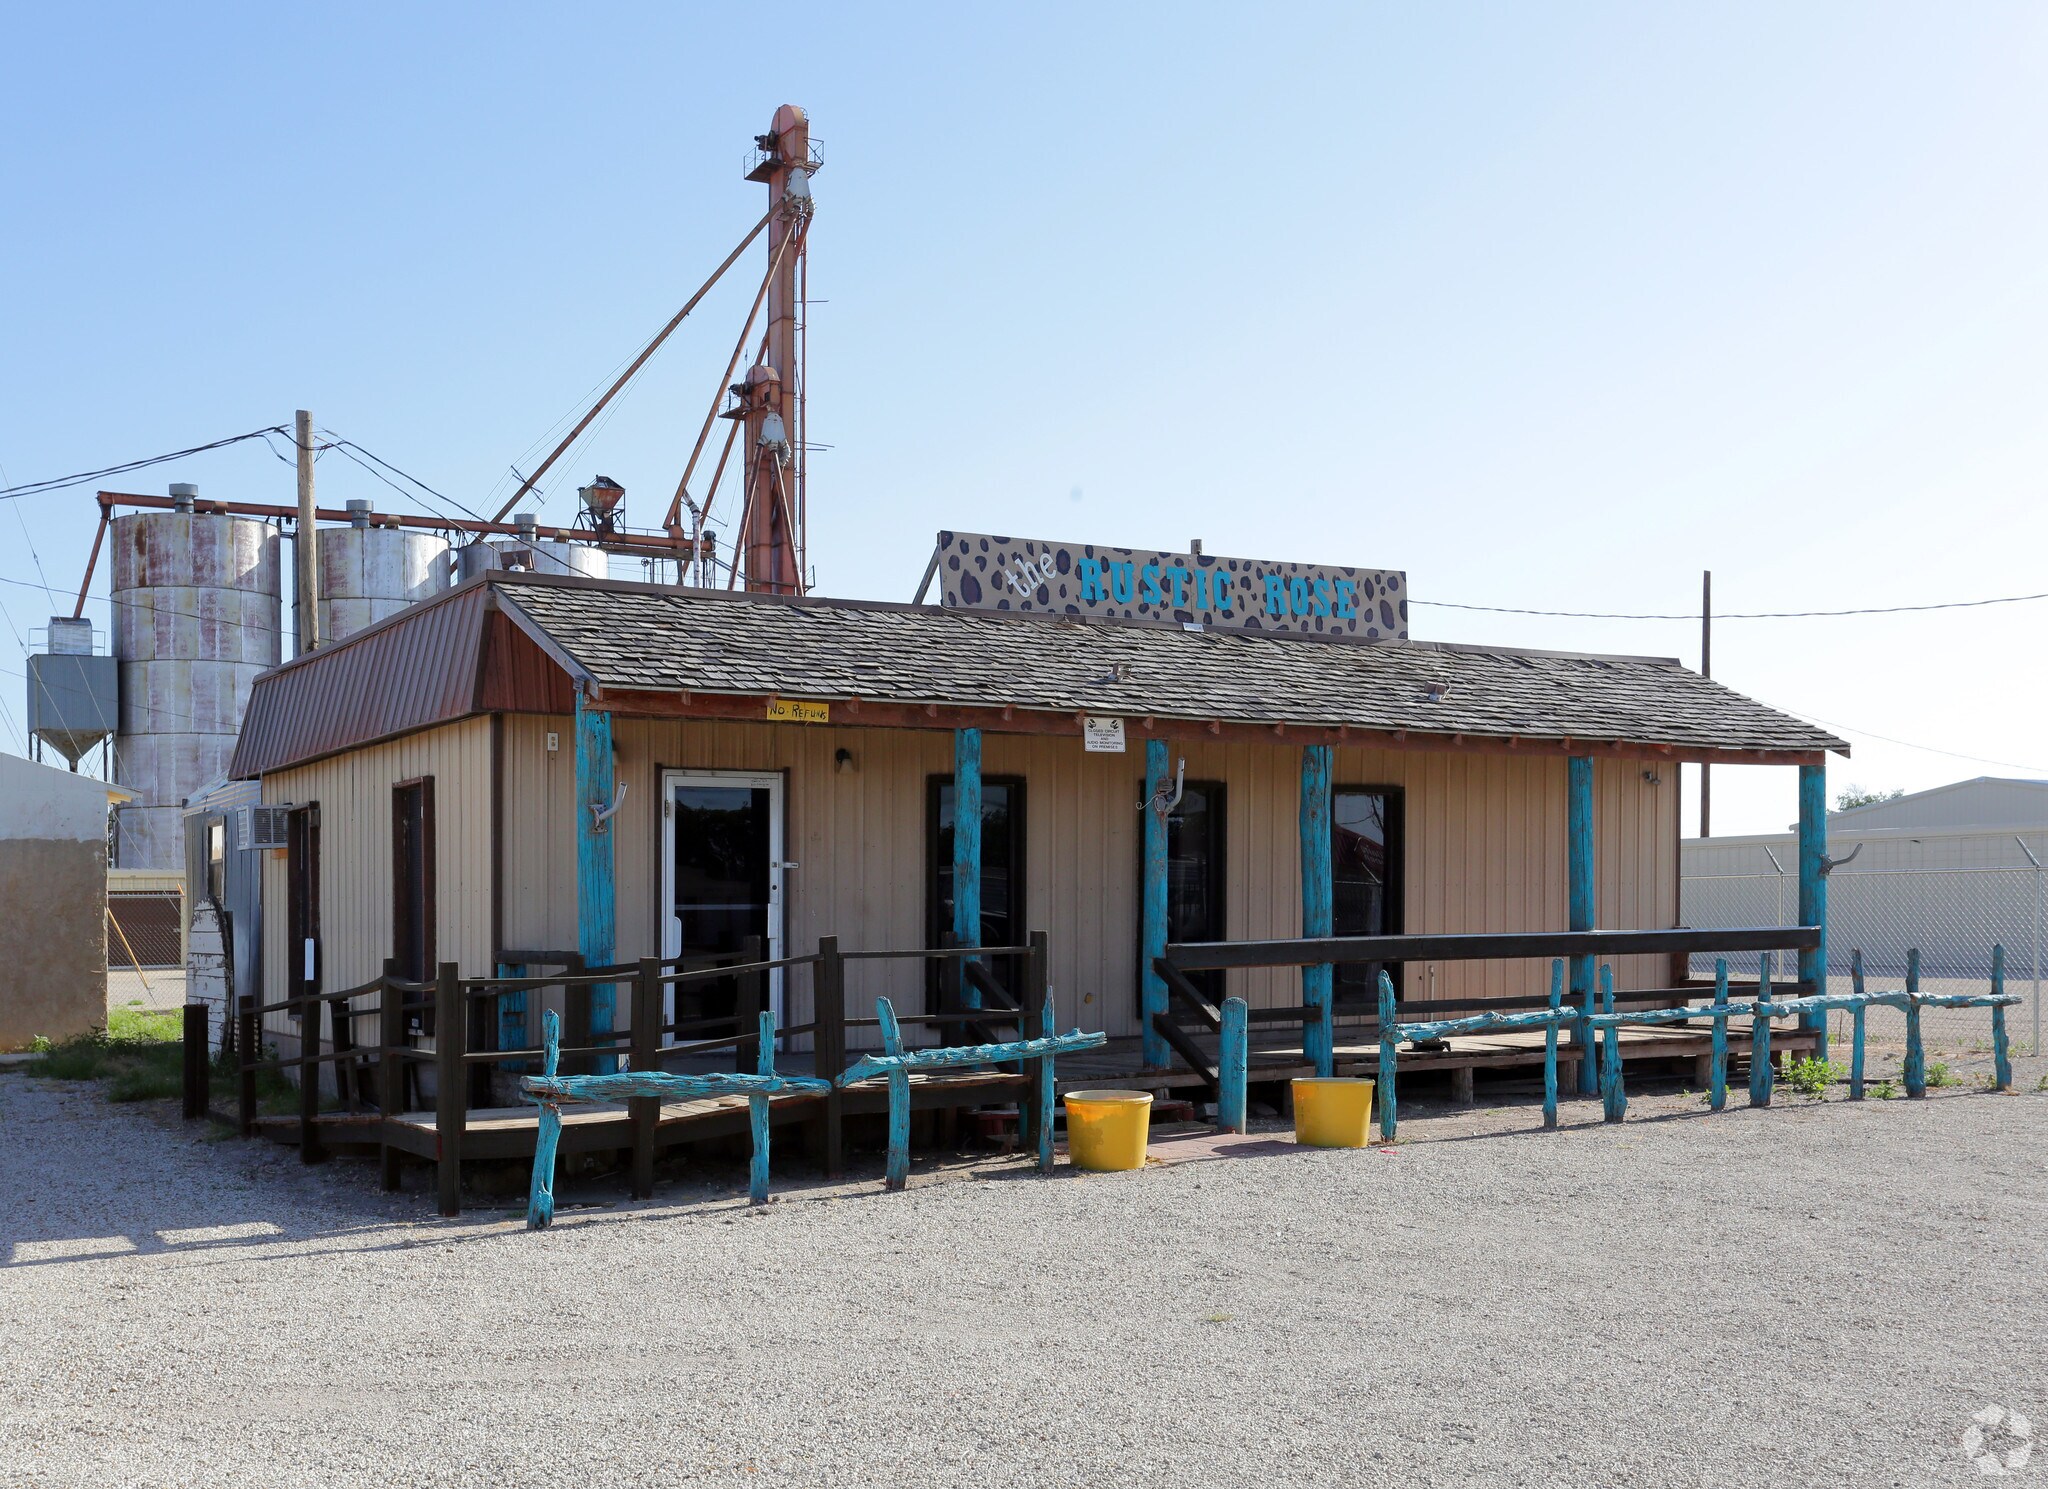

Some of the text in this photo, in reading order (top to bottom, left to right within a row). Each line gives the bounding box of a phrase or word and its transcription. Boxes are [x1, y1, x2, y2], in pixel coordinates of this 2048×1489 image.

[1004, 552, 1357, 620] the RUSTIC ROSE
